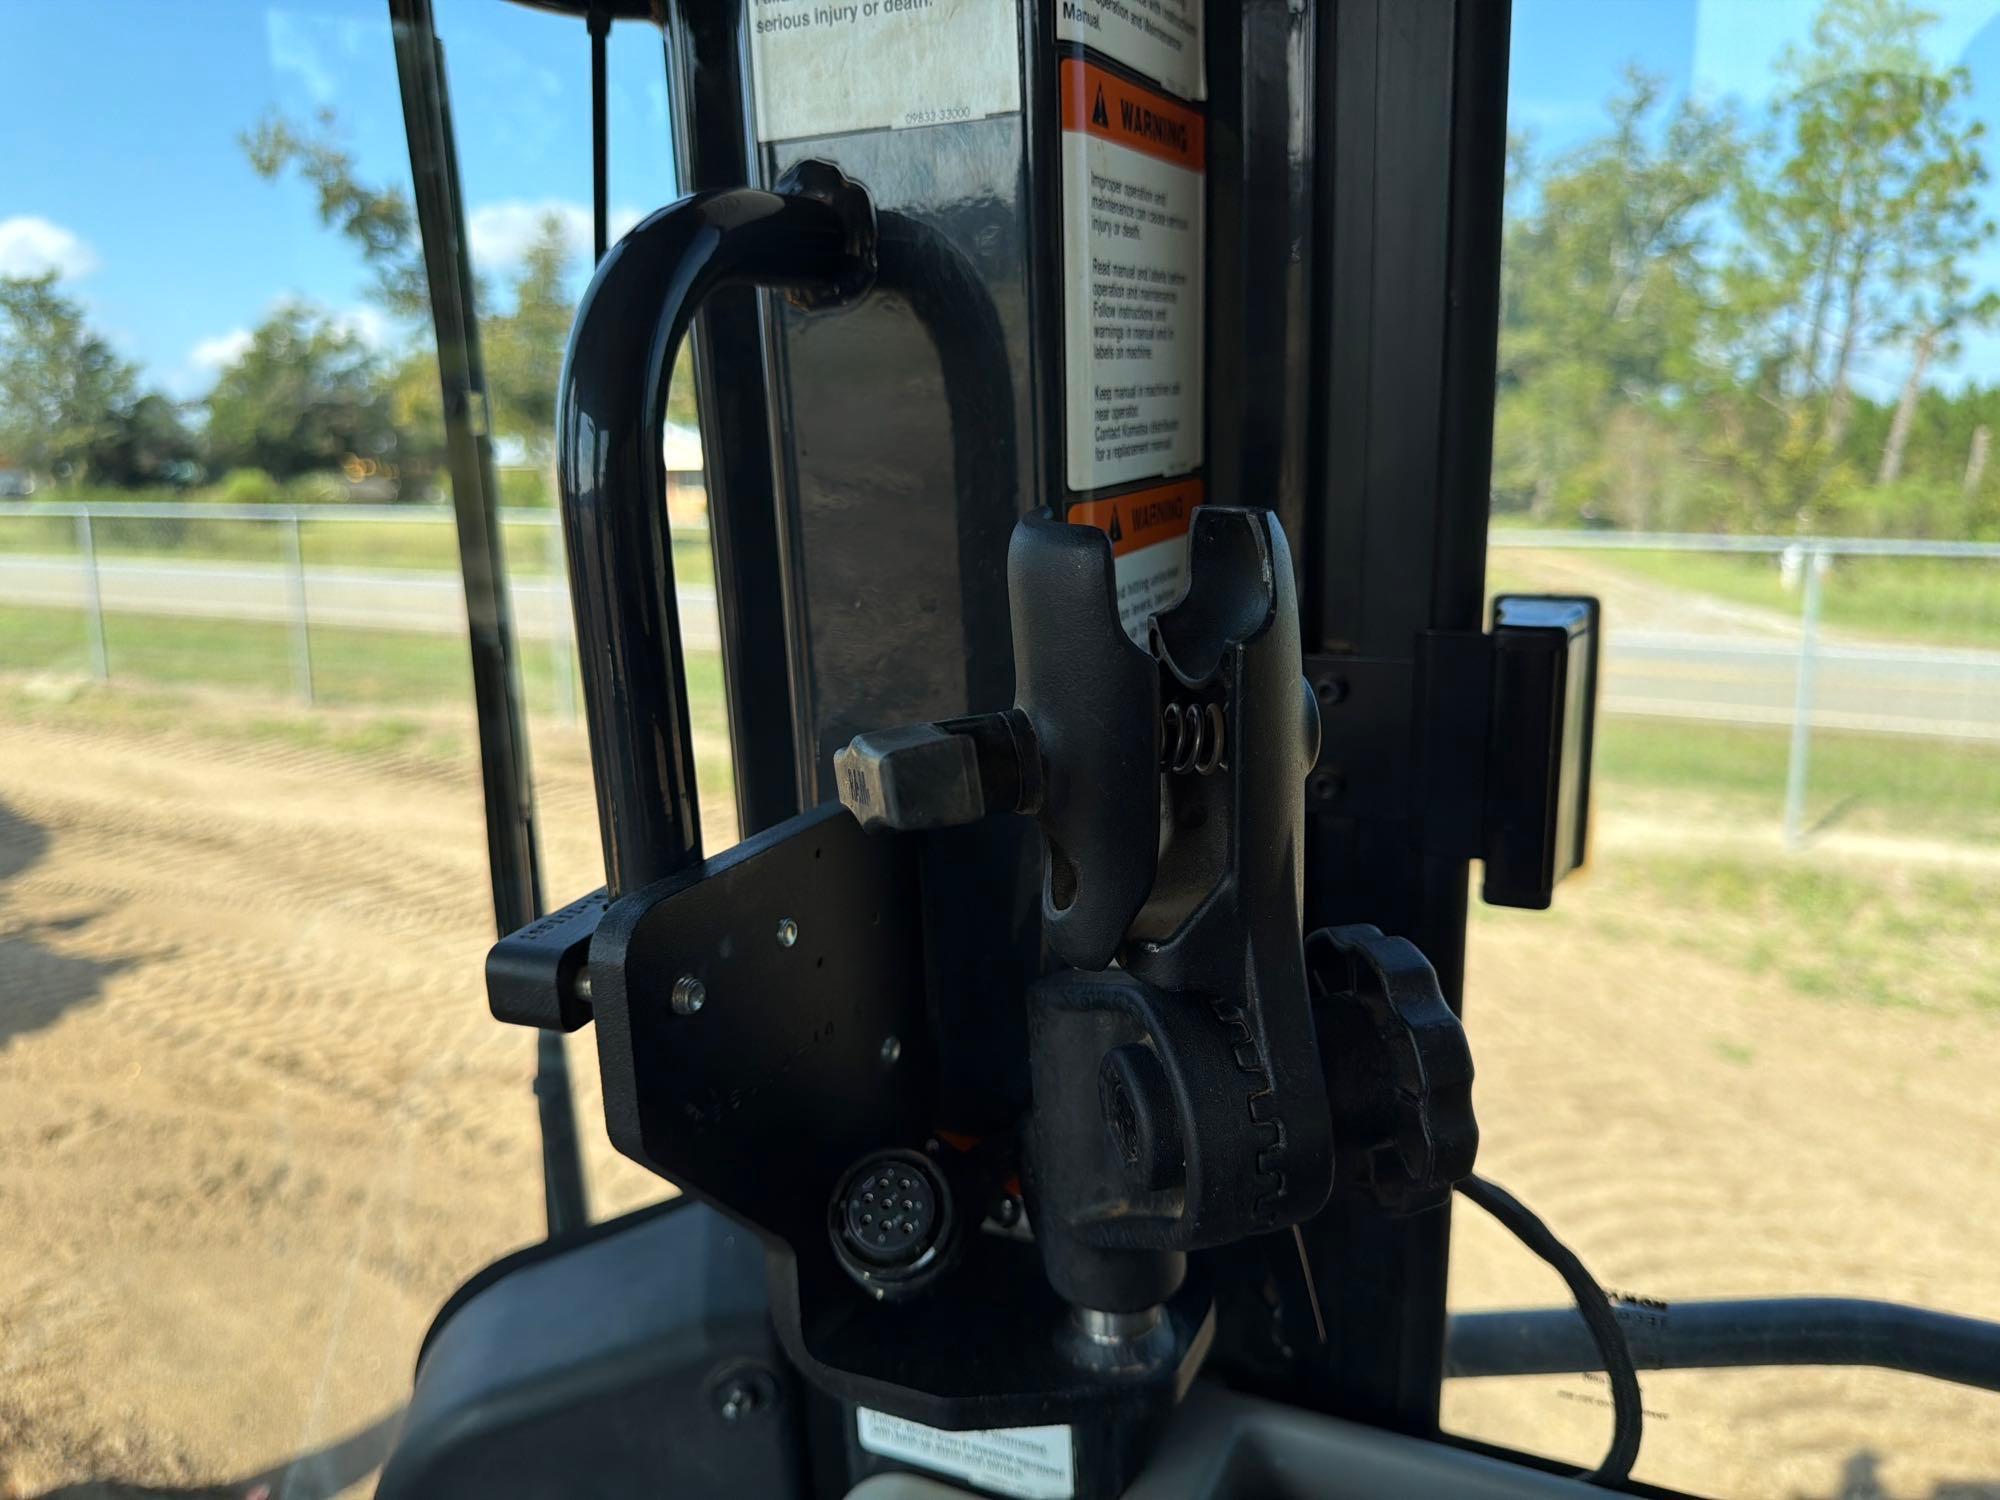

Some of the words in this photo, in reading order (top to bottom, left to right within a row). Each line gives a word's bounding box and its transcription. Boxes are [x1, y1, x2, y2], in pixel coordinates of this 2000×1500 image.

[756, 12, 811, 34] serious
[814, 5, 858, 28] injury
[863, 2, 880, 17] or
[1120, 98, 1187, 153] WARNING
[1092, 256, 1111, 276] Read
[1094, 384, 1112, 404] Keep
[1094, 422, 1120, 442] Contact
